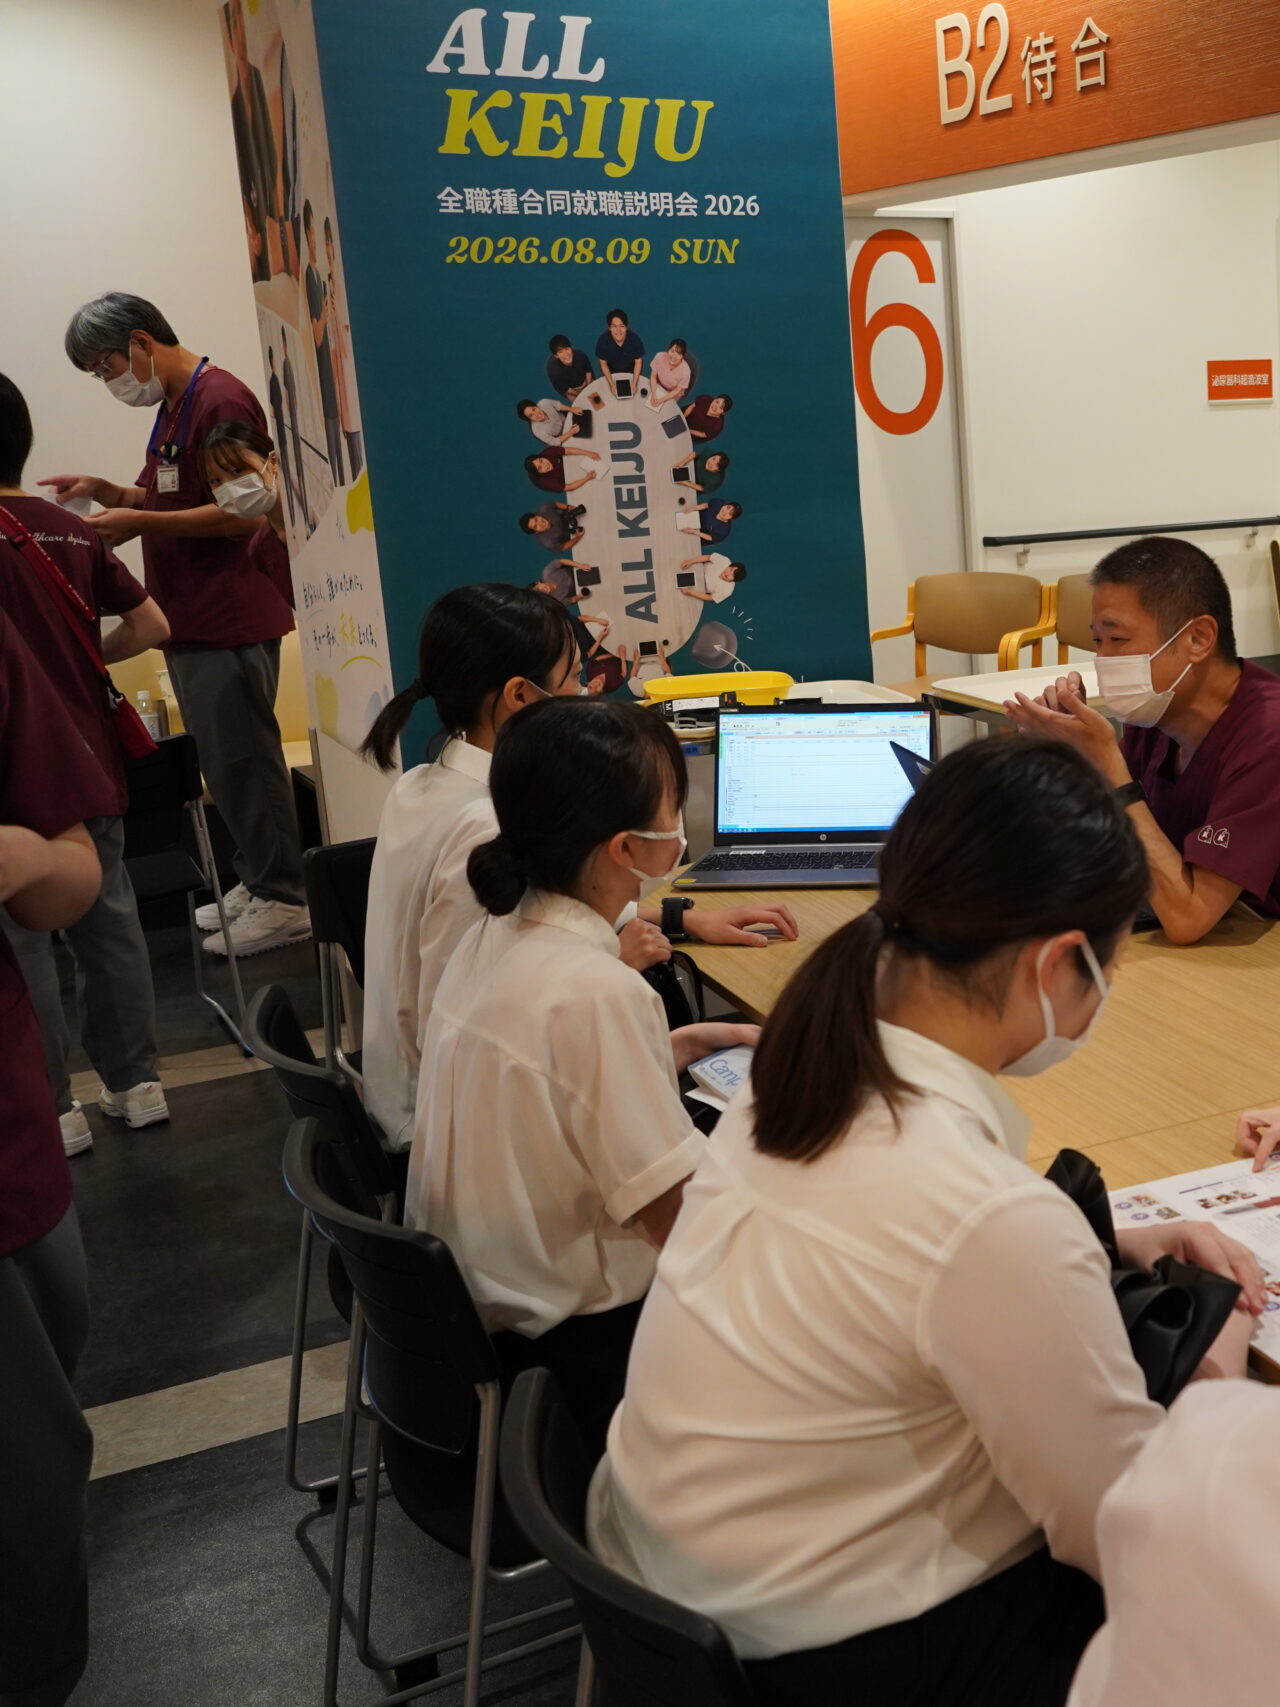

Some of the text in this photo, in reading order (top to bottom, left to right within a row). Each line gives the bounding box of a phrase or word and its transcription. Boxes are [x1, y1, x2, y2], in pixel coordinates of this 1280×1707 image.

[425, 7, 606, 82] ALL
[935, 2, 1110, 125] B2待合
[437, 88, 714, 178] KEIJU
[436, 186, 760, 217] 全職種合同就職説明会 2026
[445, 236, 740, 265] 2026.08.09 SUN
[848, 228, 944, 436] 6
[607, 421, 659, 624] ALL KEIJU
